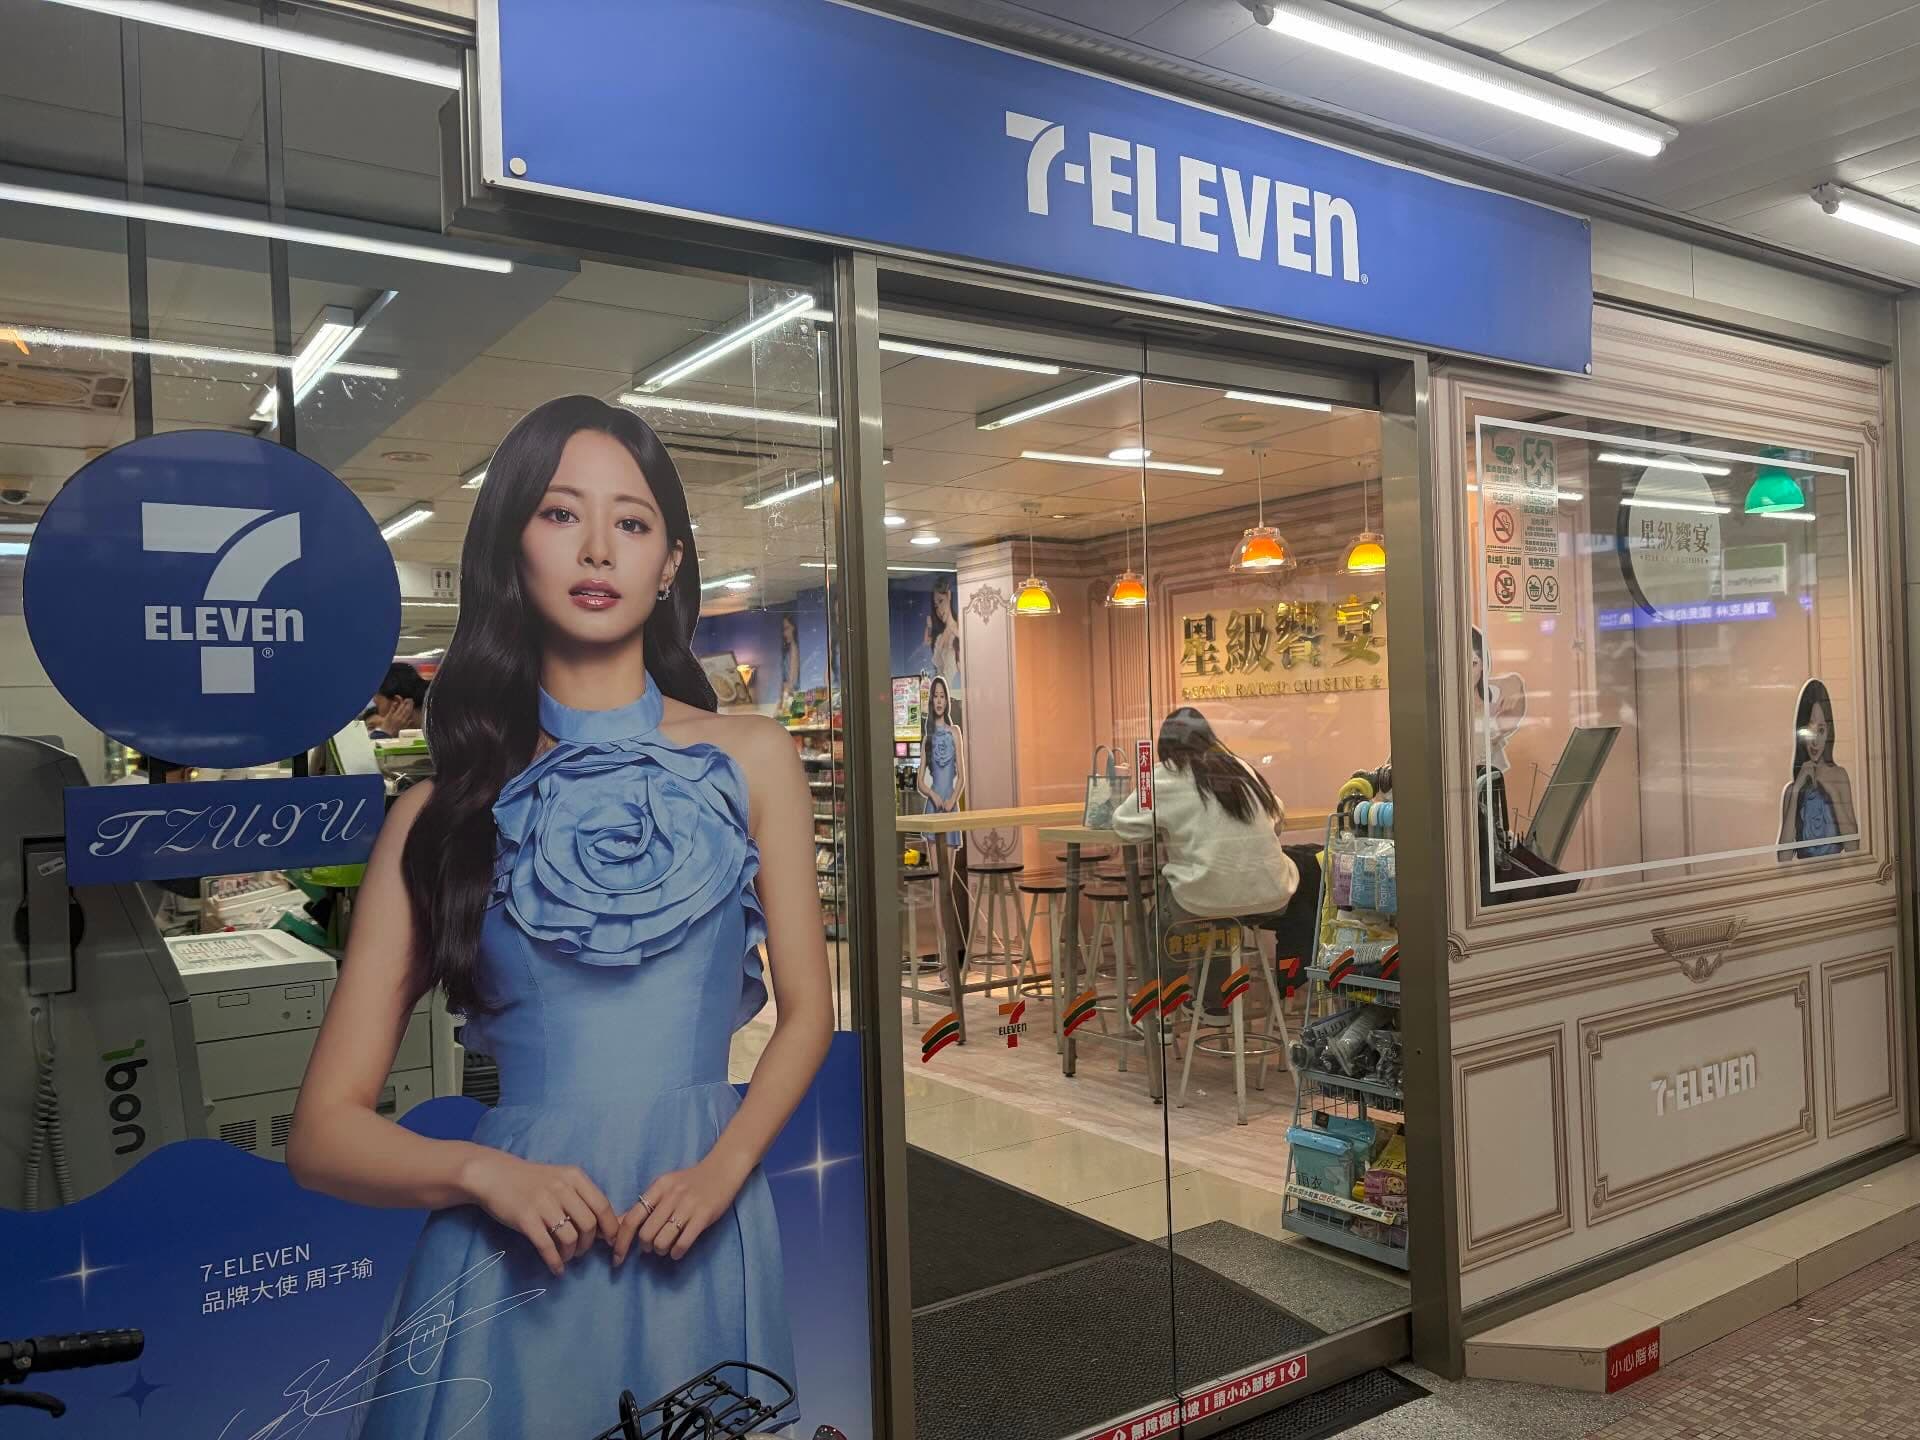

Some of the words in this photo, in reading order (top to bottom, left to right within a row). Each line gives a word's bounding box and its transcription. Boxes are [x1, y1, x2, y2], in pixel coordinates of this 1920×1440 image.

[1639, 519, 1710, 553] 星級饗宴
[101, 1038, 148, 1155] ibon
[200, 1243, 310, 1283] 7-ELEVEN
[202, 1274, 299, 1315] 品牌大使
[305, 1257, 374, 1292] 周子瑜
[1610, 1340, 1659, 1378] 小心階梯
